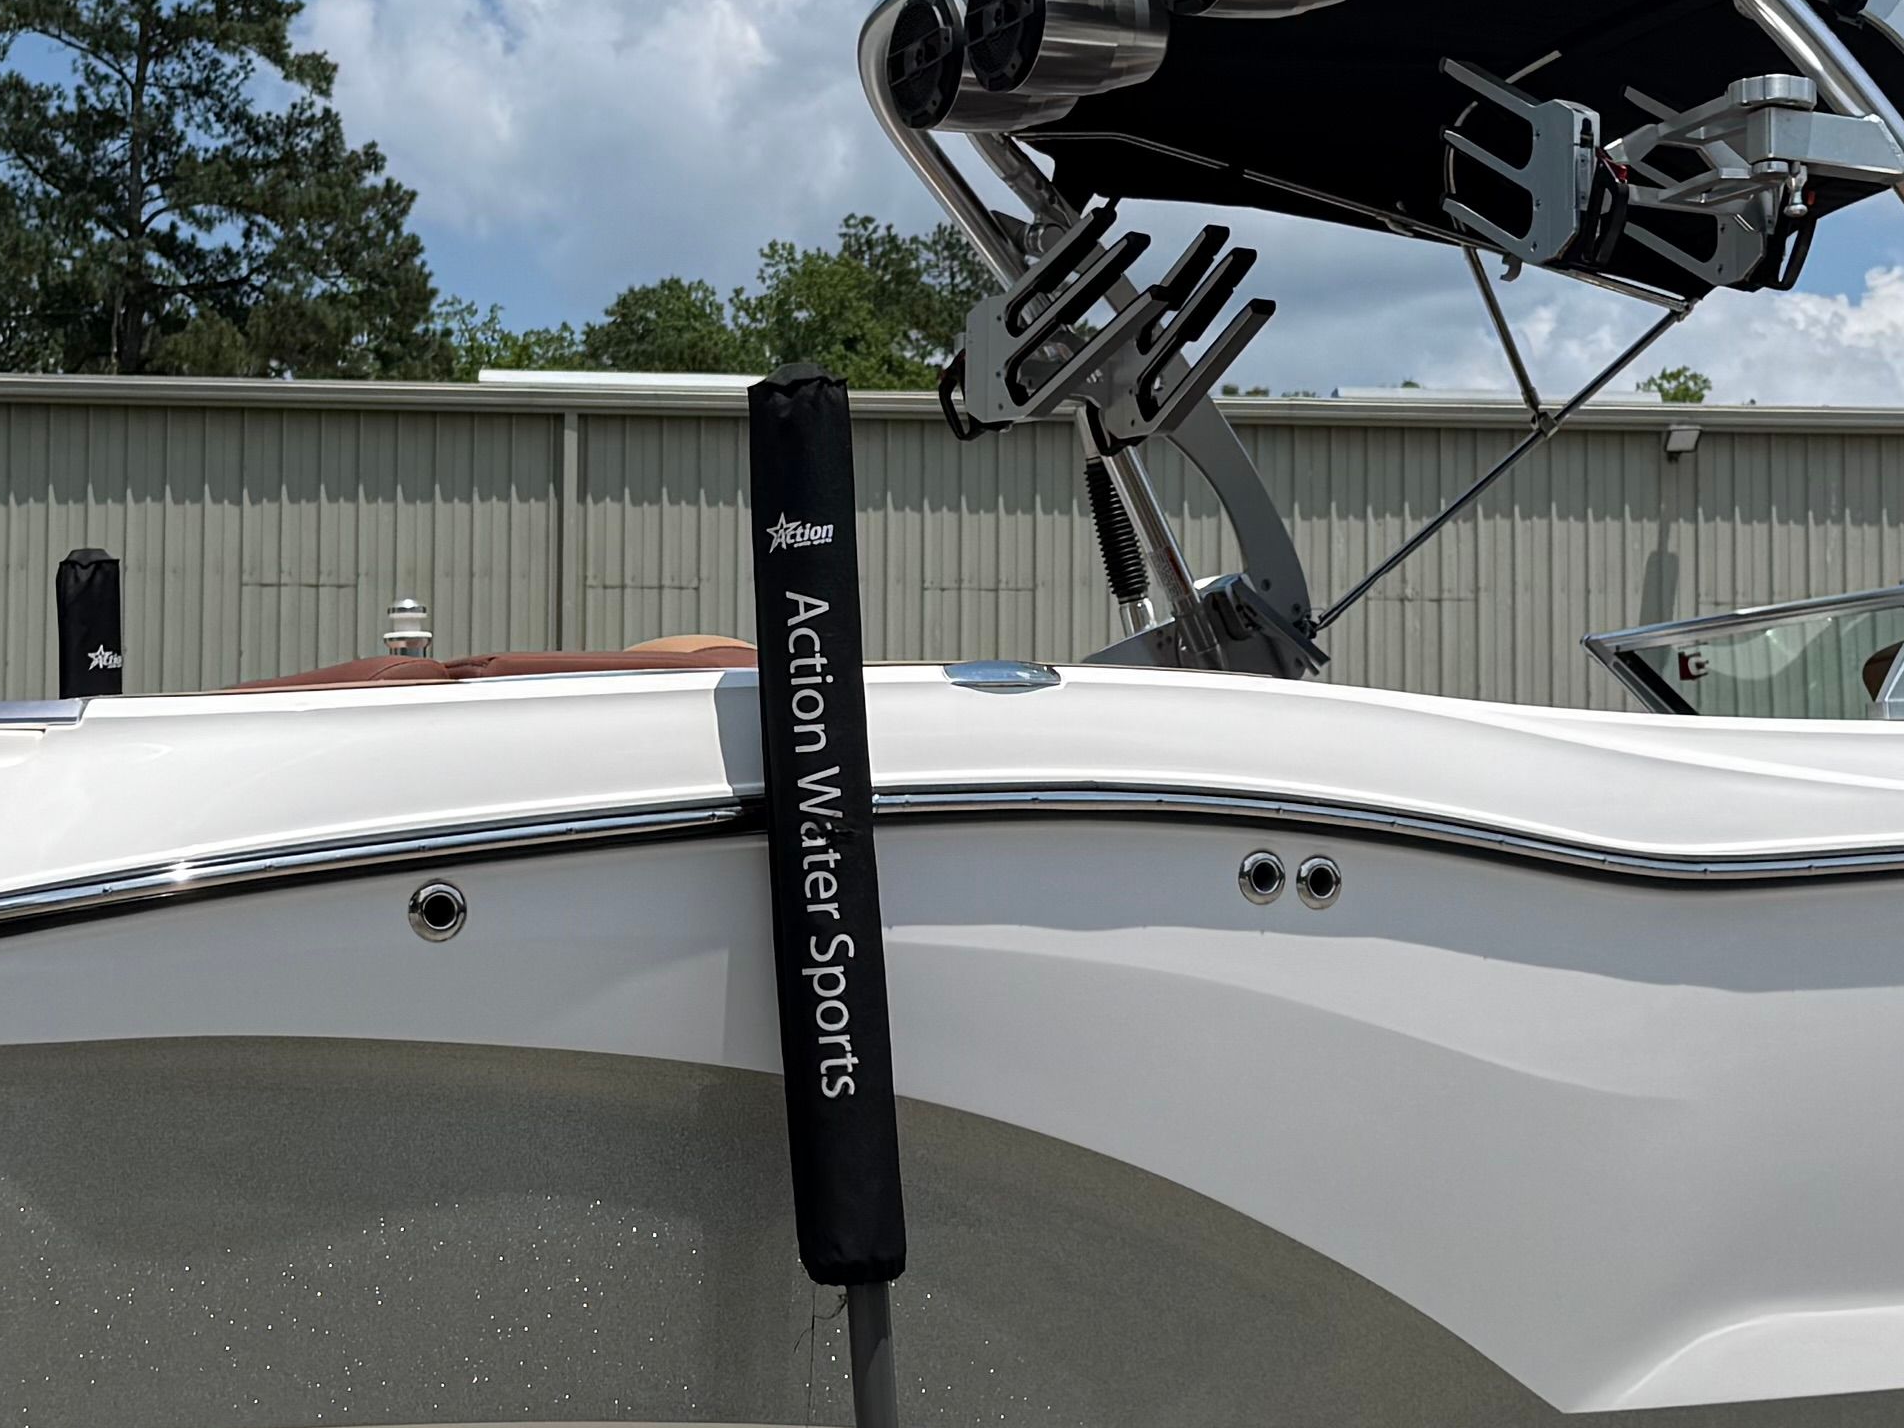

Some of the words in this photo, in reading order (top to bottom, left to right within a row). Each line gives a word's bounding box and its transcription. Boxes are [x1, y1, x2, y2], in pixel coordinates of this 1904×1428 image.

[784, 590, 834, 754] Action
[796, 765, 844, 920] Water
[801, 933, 860, 1099] Sports
